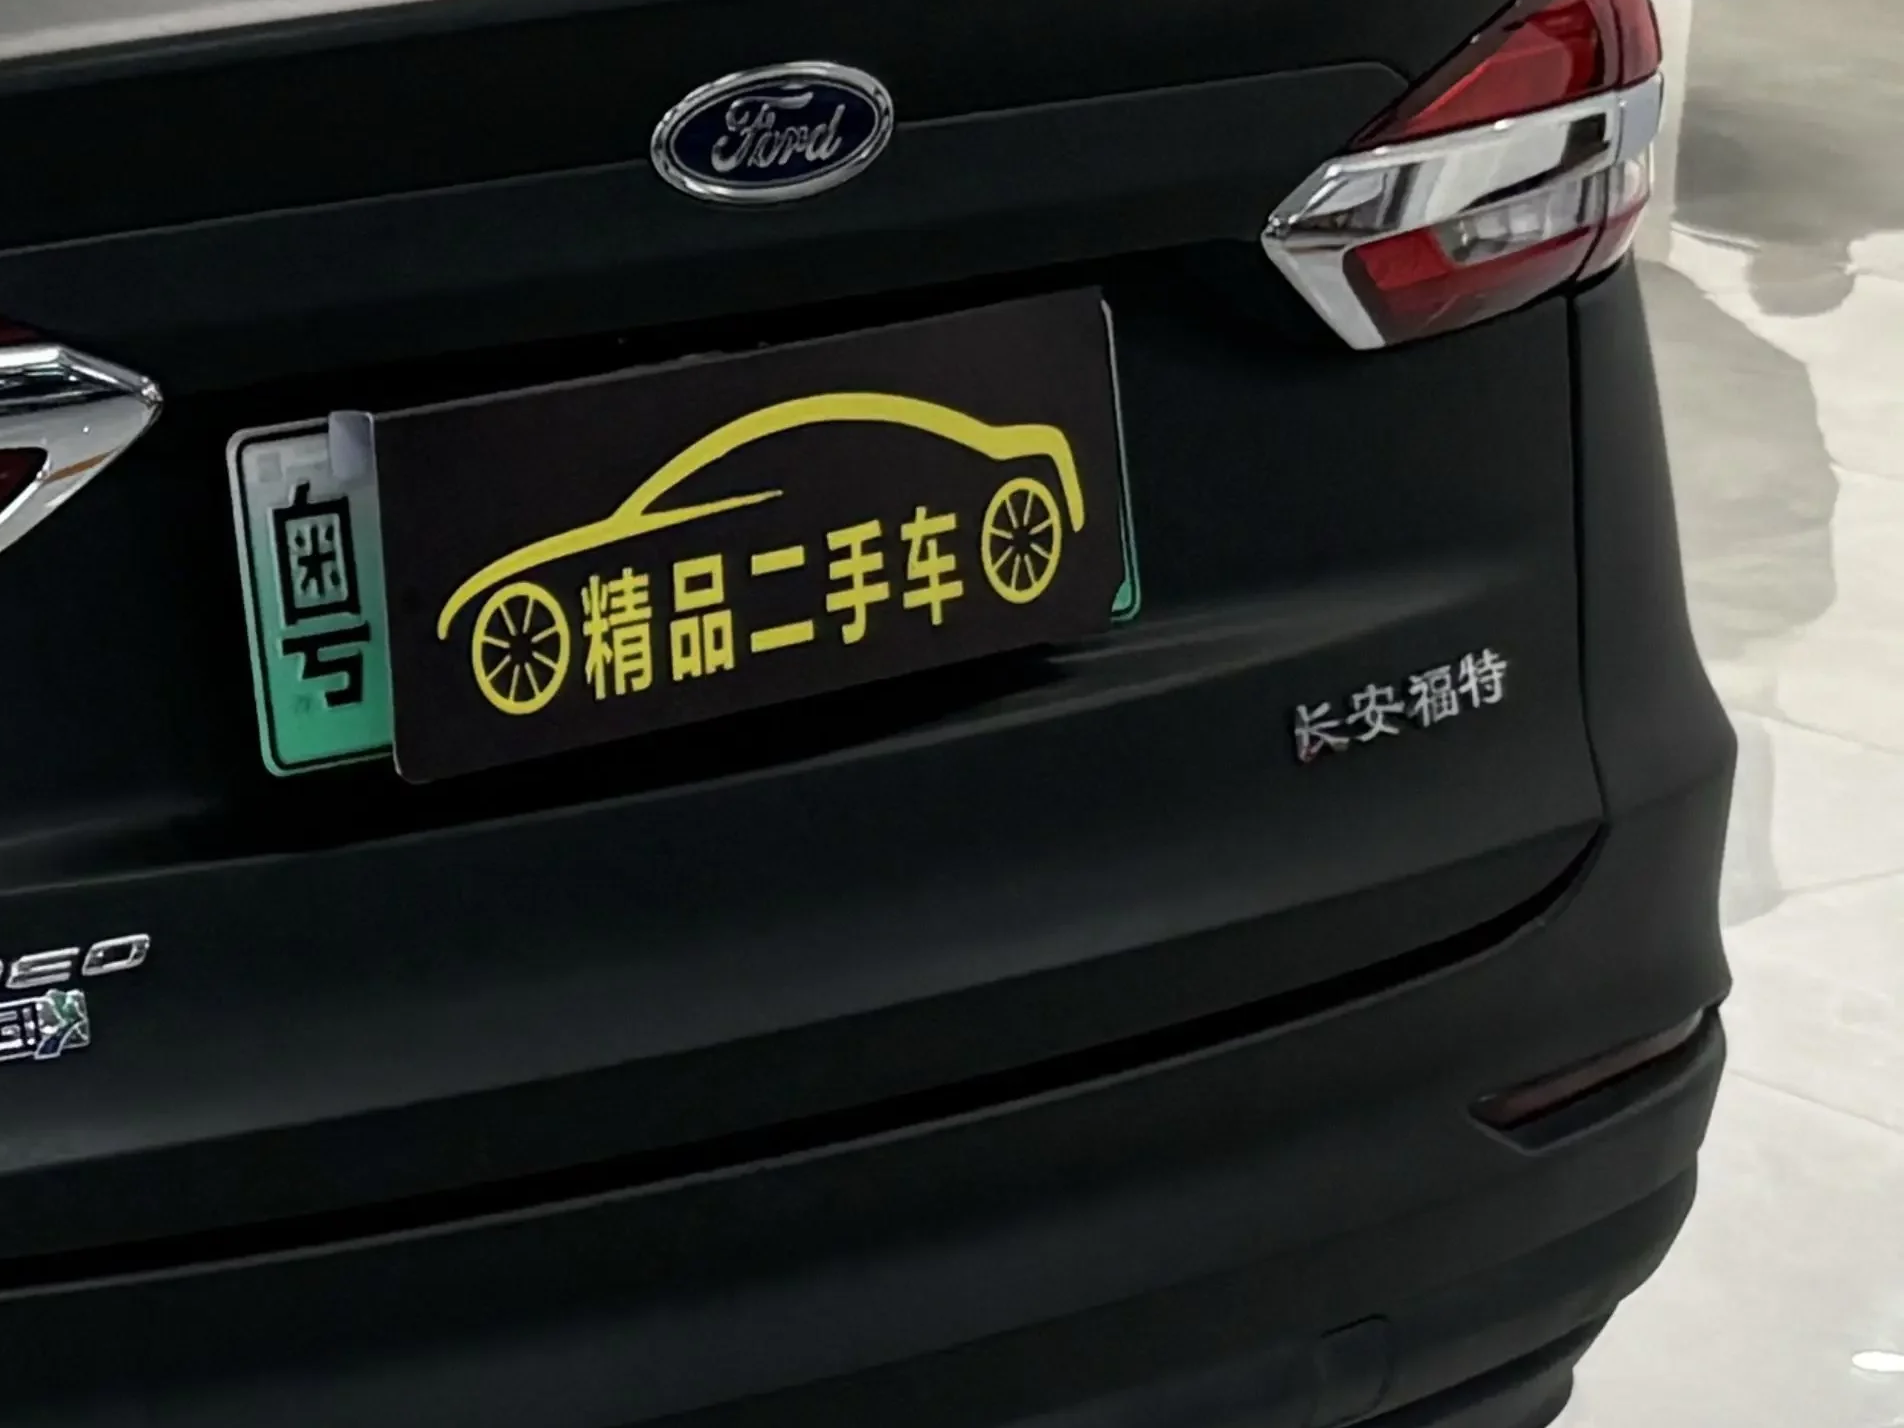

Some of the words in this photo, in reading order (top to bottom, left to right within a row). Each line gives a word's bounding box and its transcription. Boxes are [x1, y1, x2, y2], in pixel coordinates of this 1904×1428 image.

[711, 92, 846, 172] Ford
[580, 505, 964, 700] 精品二手车
[1293, 647, 1508, 764] 长安福特
